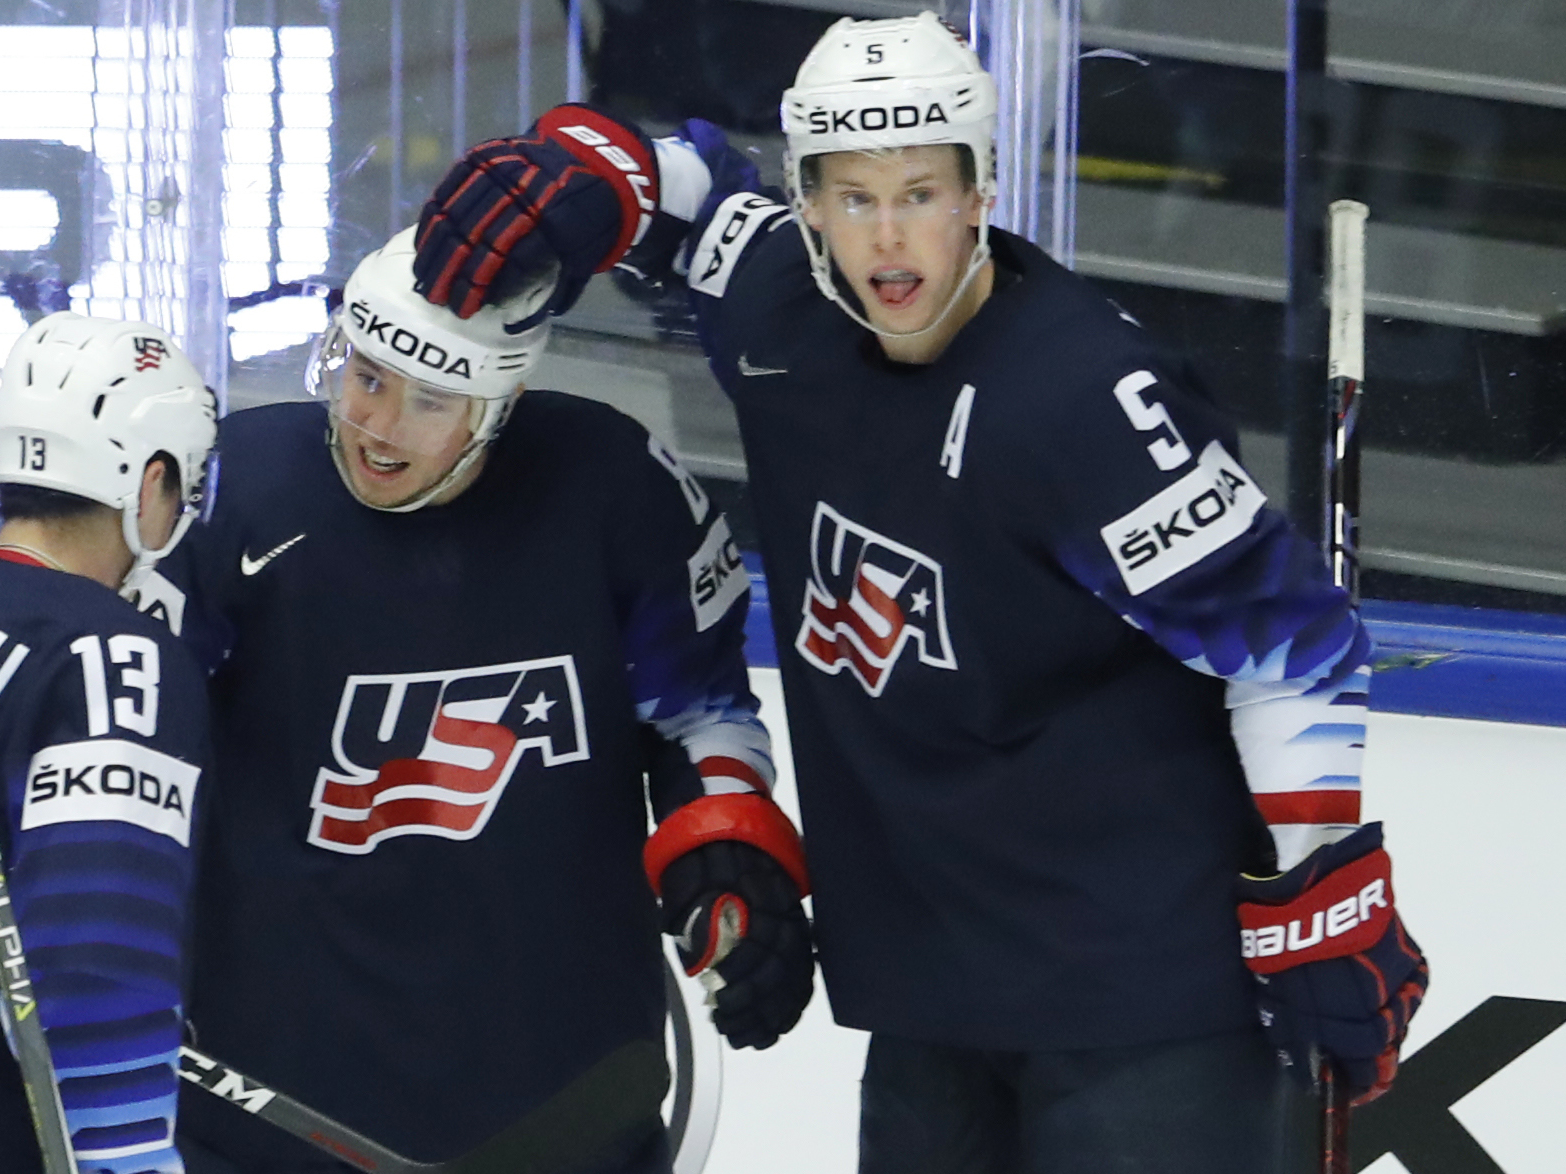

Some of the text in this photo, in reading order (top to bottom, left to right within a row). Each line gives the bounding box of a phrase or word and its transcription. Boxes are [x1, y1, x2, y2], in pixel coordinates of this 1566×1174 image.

[865, 43, 885, 65] 5
[809, 103, 949, 135] ŠKODA
[350, 300, 472, 379] ŠKODA
[18, 435, 47, 471] 13
[939, 384, 976, 479] A
[1112, 369, 1193, 471] 5
[70, 633, 161, 738] 13
[30, 763, 186, 819] ŠKODA
[306, 655, 591, 855] USA
[1240, 878, 1388, 958] BAUER
[175, 1045, 277, 1114] CM
